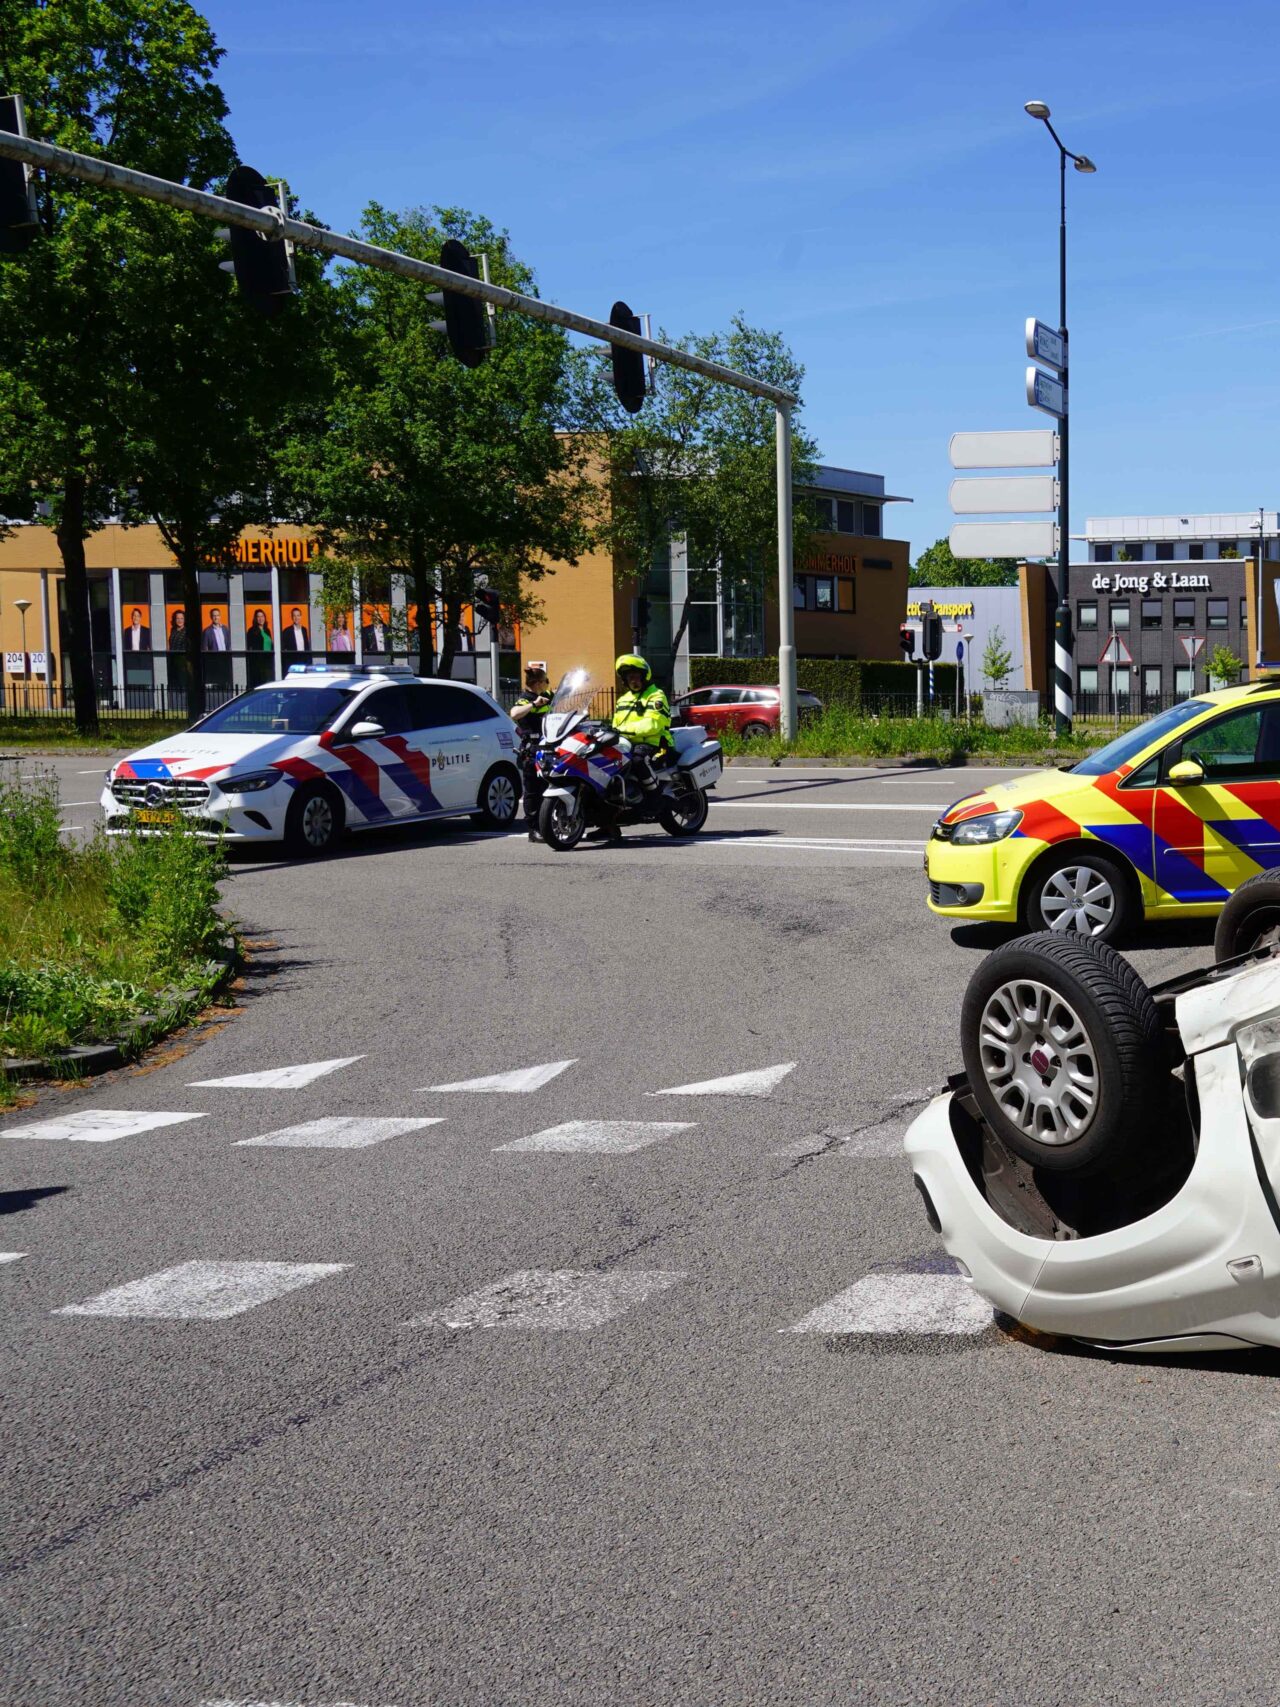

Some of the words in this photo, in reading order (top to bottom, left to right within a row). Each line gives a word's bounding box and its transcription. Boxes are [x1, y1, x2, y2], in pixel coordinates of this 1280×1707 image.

[1092, 573, 1110, 589] de
[1112, 573, 1149, 592] Jong
[1152, 571, 1168, 588] &
[1171, 572, 1210, 587] Laan
[933, 601, 973, 619] ransport
[7, 653, 23, 663] 204
[431, 751, 471, 770] POLITIE
